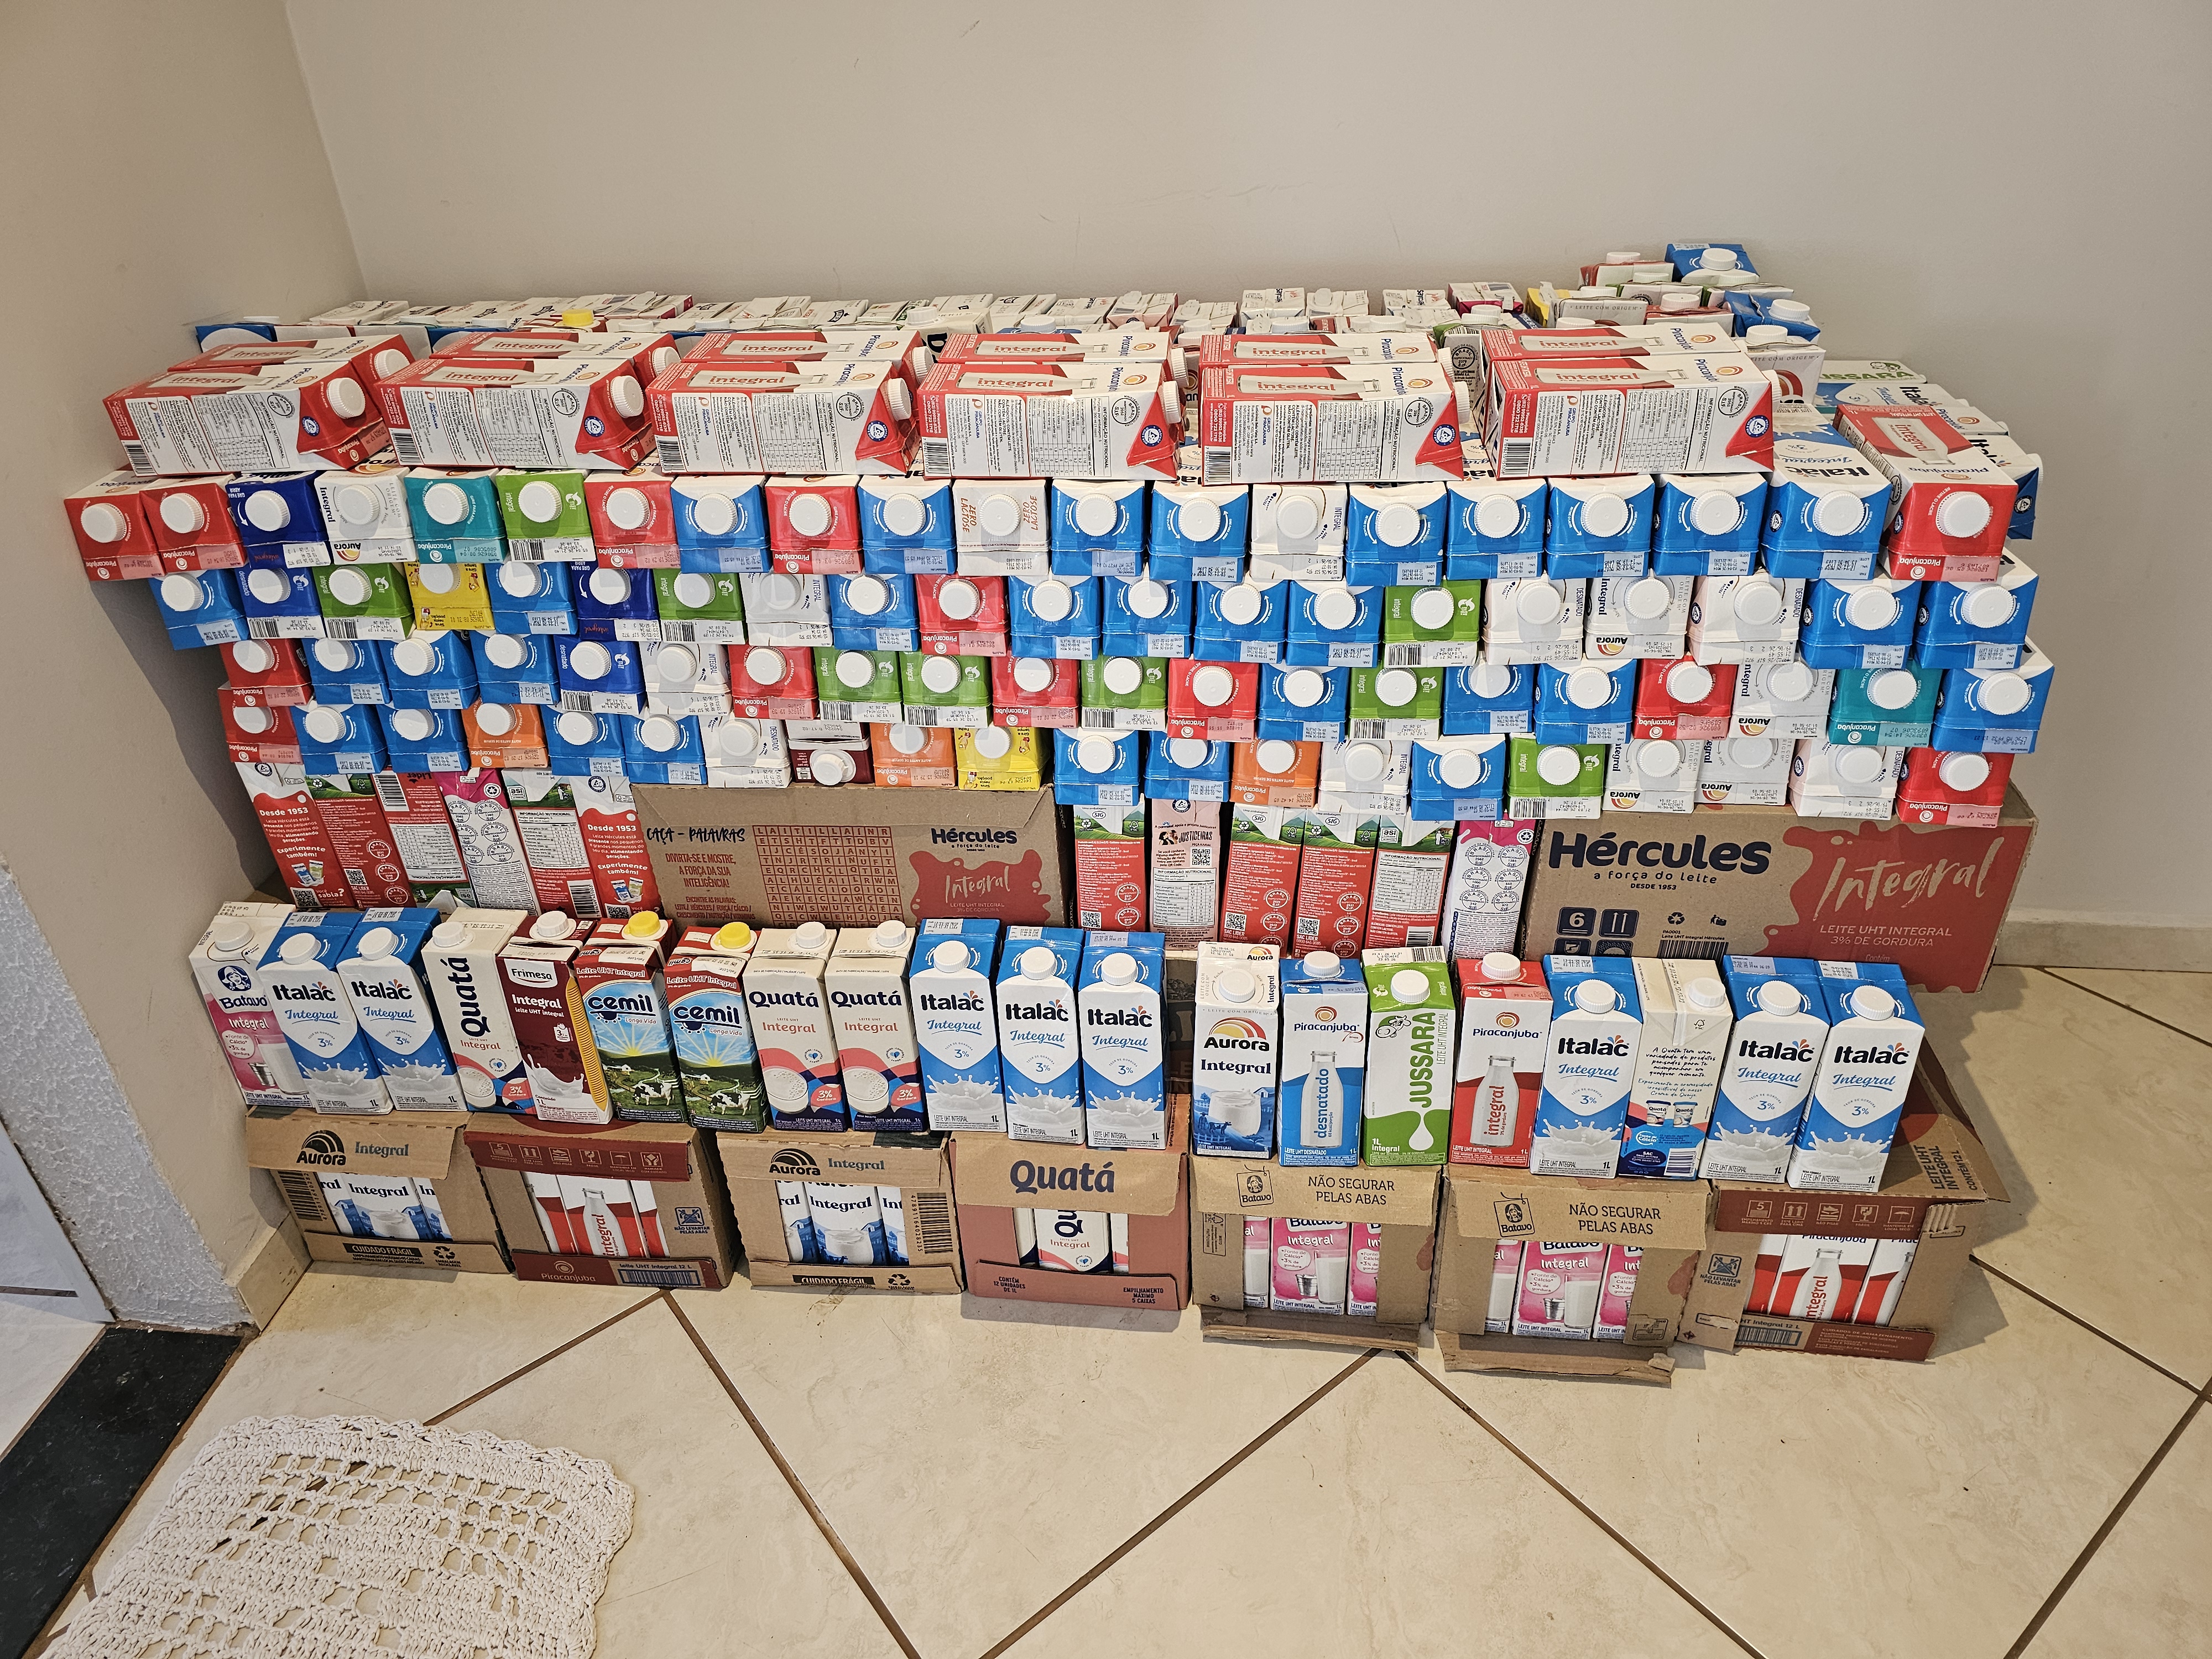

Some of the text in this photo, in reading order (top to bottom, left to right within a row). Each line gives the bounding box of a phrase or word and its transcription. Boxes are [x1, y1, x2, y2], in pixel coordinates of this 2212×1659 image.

[494, 342, 562, 350] integral
[1556, 373, 1640, 381] integral
[1258, 382, 1336, 391] integral
[1698, 398, 1714, 463] INFORMAÇÃO NUTRICIONAL
[1784, 466, 1870, 476] Italac
[960, 498, 970, 533] LACTOSE
[968, 505, 977, 526] ZERO
[813, 579, 821, 602] INTEGRAL
[1793, 588, 1803, 618] DESNATADO
[1892, 750, 1903, 778] DESNATADO
[287, 807, 309, 815] 1953
[665, 853, 736, 864] DIVIRTA-SE E MOSTRE,
[1548, 831, 1771, 874] Hércules
[679, 866, 731, 877] A FORÇA DA SUA
[1594, 870, 1718, 884] a força do leite
[684, 877, 730, 888] INTELIGÊNCIA!
[1813, 837, 2004, 921] Integral
[1569, 912, 1585, 927] 6
[1820, 925, 1952, 936] LEITE UHT INTEGRAL
[1830, 936, 1933, 946] 3% DE GORDURA
[1865, 954, 1890, 963] Contém
[512, 968, 552, 981] Frimesa
[614, 969, 645, 978] Integral
[219, 998, 268, 1009] Batavo
[588, 995, 653, 1012] cemil
[1294, 1022, 1357, 1032] Piracanjuba
[1473, 1028, 1540, 1039] Piracanjuba
[1204, 1037, 1269, 1051] Aurora
[1558, 1038, 1629, 1057] Italac
[1739, 1040, 1813, 1062] Italac
[1201, 1059, 1271, 1074] Integral
[1409, 1012, 1436, 1108] JUSSARA
[1650, 1070, 1674, 1079] qualquer
[818, 1090, 832, 1098] 3%
[899, 1089, 913, 1097] 3%
[1317, 1068, 1328, 1139] desnatado
[1372, 1145, 1400, 1153] Integral
[296, 1153, 346, 1166] Aurora
[769, 1164, 821, 1176] Aurora
[1913, 1145, 1945, 1190] LEITE UHT
[1928, 1145, 1960, 1190] INTEGRAL
[1010, 1160, 1115, 1194] Quatá
[1308, 1175, 1395, 1191] NÃO SEGURAR
[1242, 1193, 1271, 1202] Batavo
[1316, 1192, 1386, 1205] PELAS ABAS
[1569, 1202, 1661, 1219] NÃO SEGURAR
[1579, 1220, 1653, 1235] PELAS ABAS
[541, 1273, 596, 1282] Piracanjuba
